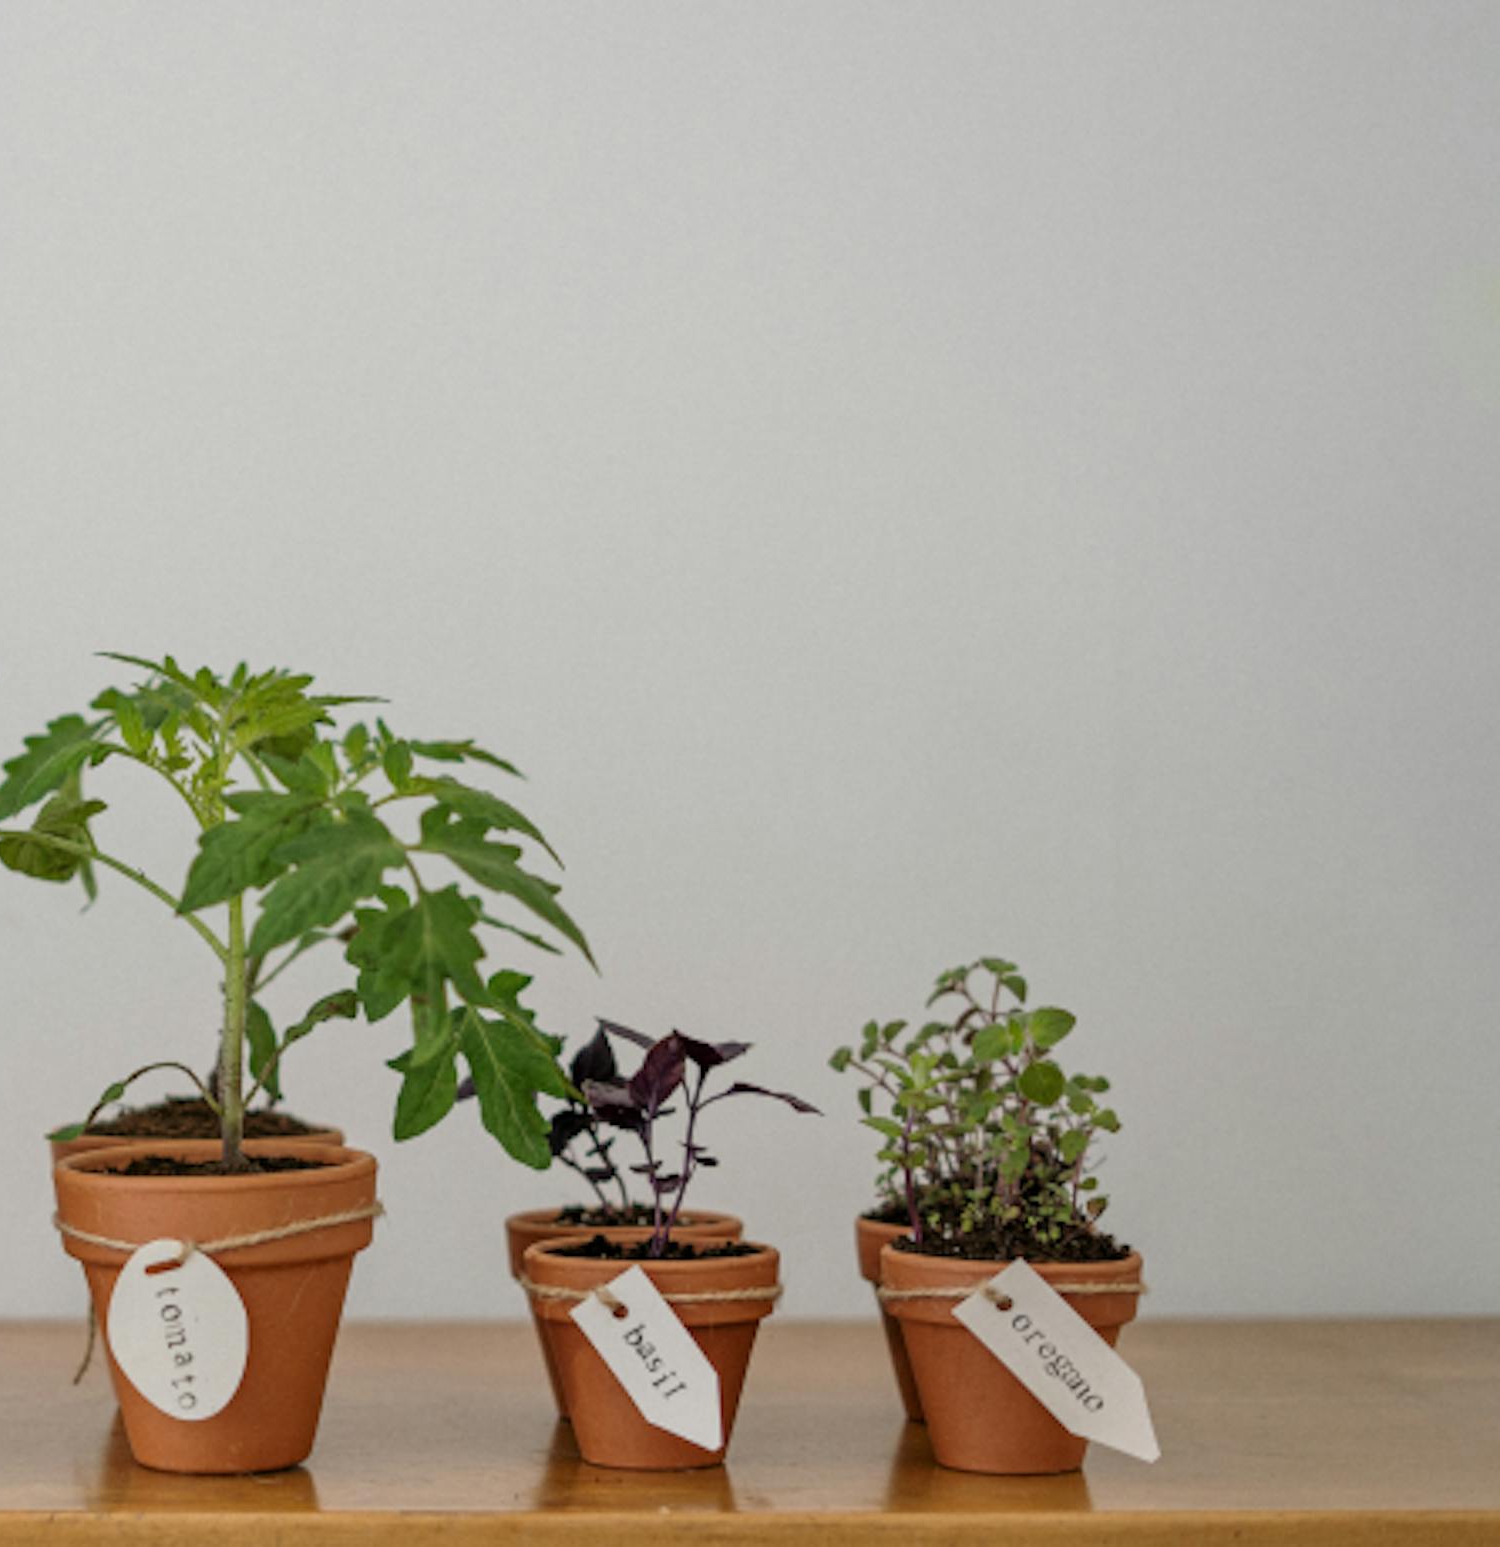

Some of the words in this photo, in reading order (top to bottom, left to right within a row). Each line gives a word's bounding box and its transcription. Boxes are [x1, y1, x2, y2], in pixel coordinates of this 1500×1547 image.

[156, 1286, 197, 1411] tomato
[623, 1323, 687, 1399] basil
[1011, 1313, 1105, 1413] oregano
